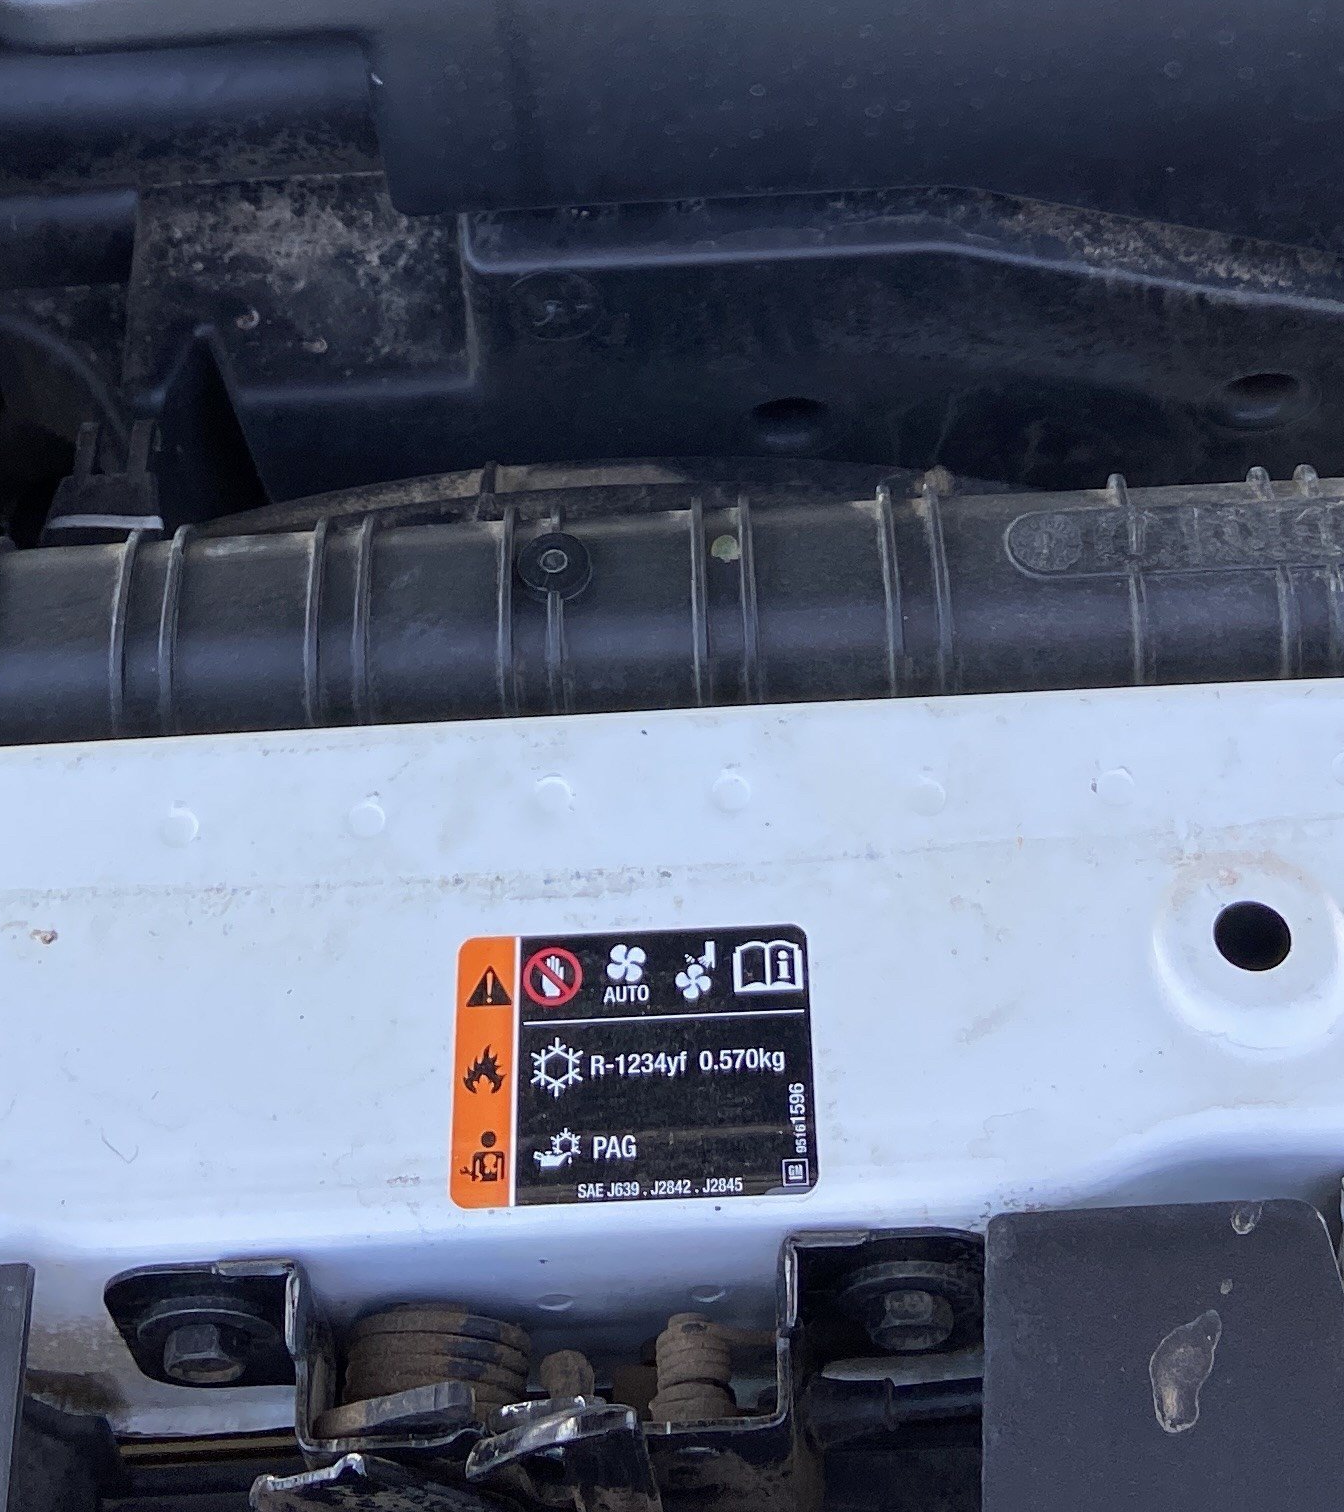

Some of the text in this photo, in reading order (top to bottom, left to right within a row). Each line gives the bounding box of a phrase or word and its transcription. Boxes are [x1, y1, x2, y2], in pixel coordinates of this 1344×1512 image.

[603, 985, 650, 1003] AUTO
[590, 1048, 785, 1076] R-1234yf 0.570kg
[592, 1135, 637, 1159] PAG
[788, 1164, 803, 1180] GM
[577, 1183, 604, 1199] SAE
[702, 1177, 743, 1193] J2845
